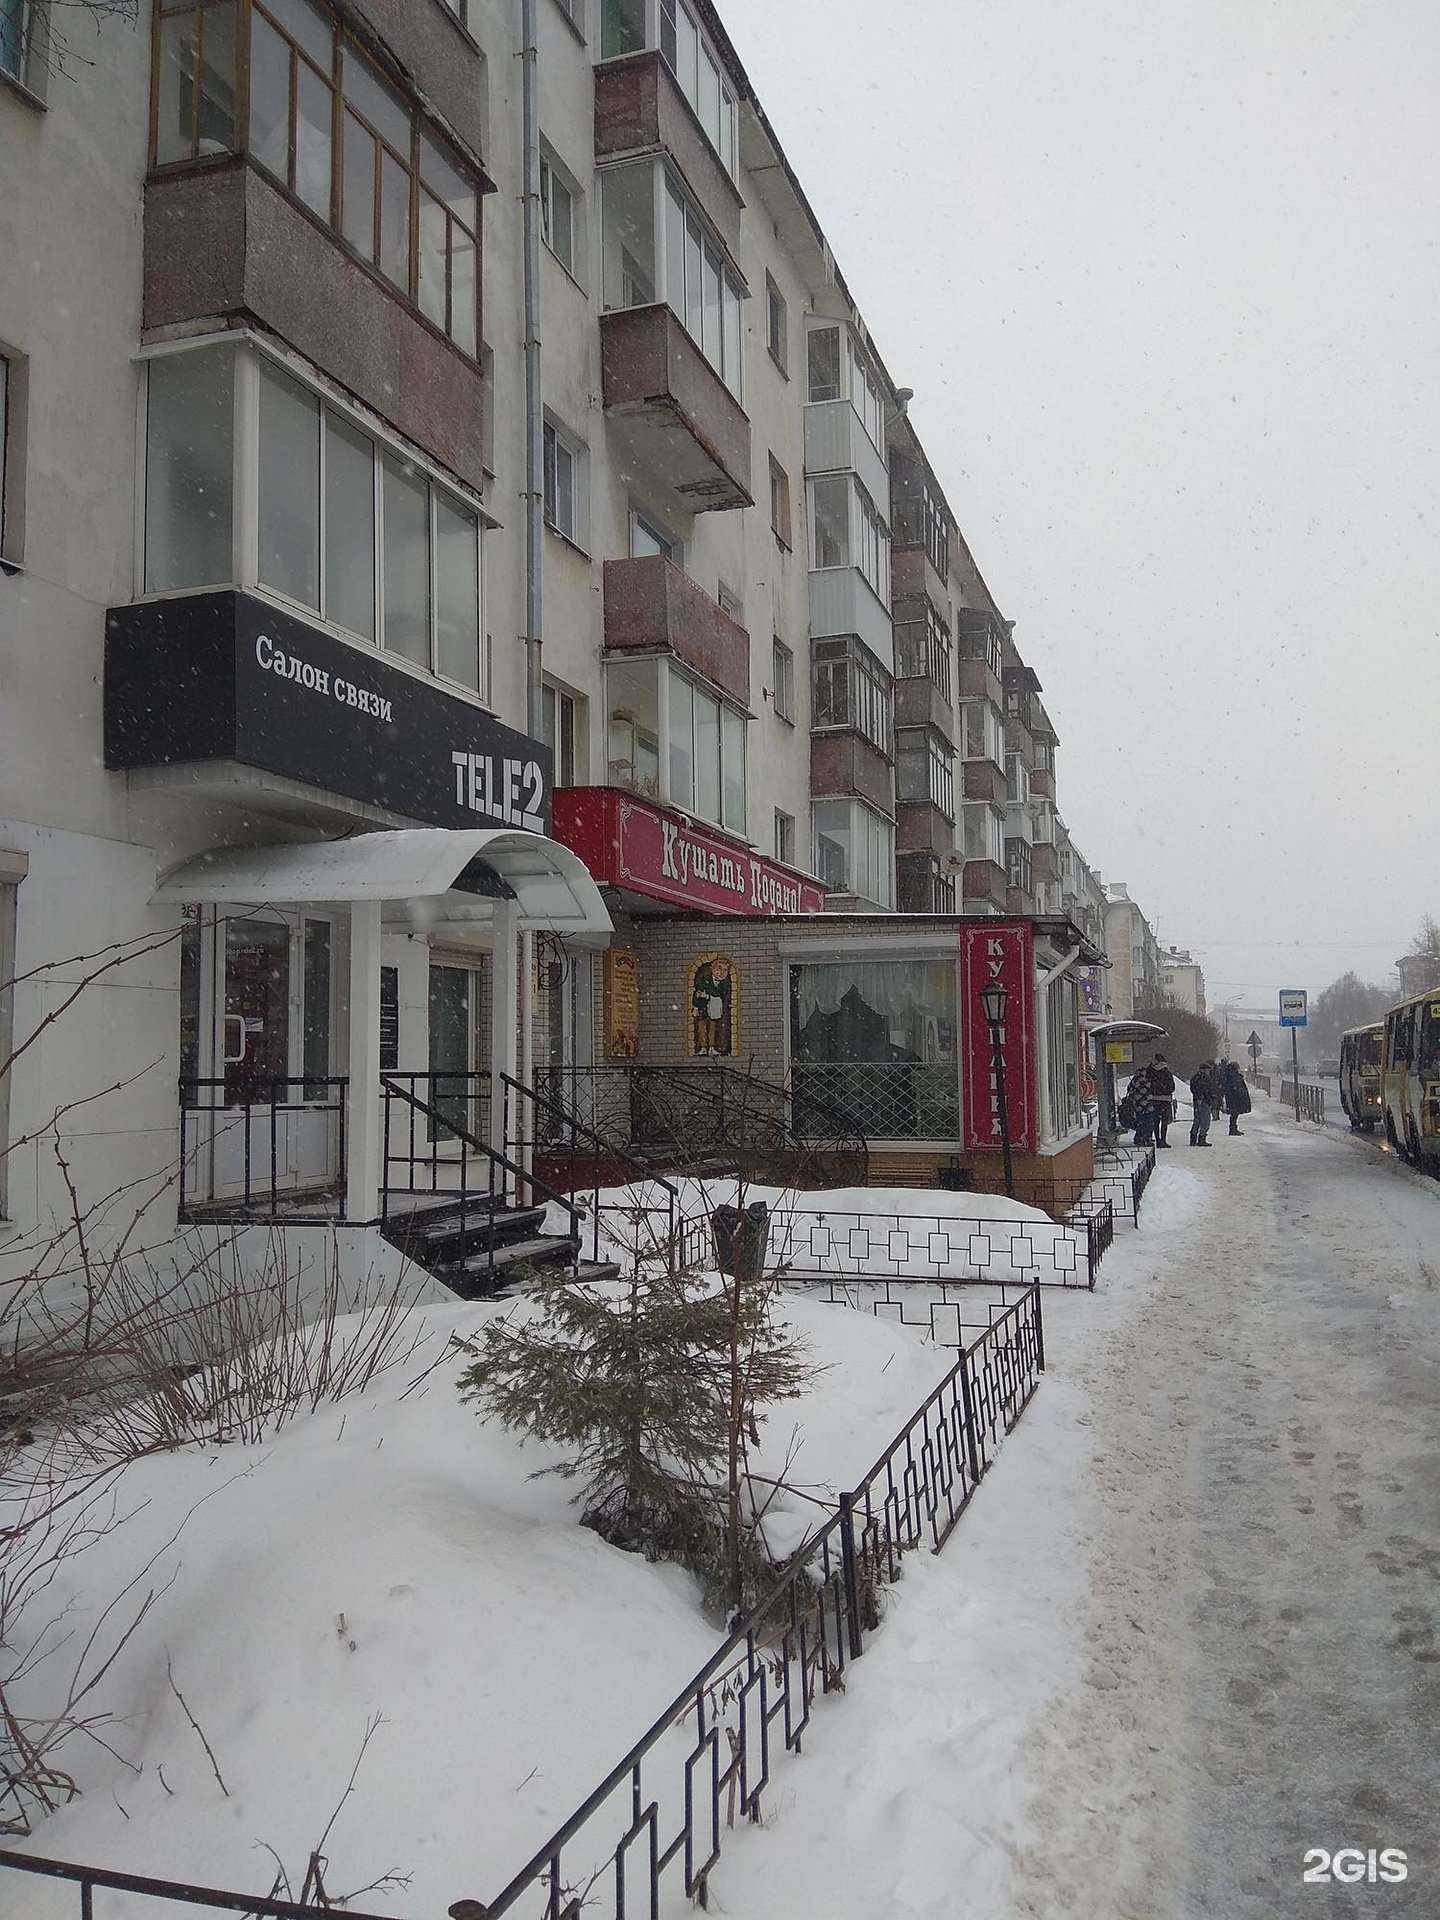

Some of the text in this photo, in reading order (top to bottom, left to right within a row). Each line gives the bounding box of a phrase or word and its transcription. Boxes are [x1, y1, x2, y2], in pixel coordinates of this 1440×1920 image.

[255, 635, 393, 723] Салон связи
[452, 751, 544, 835] TELE2
[662, 820, 746, 893] Кушать
